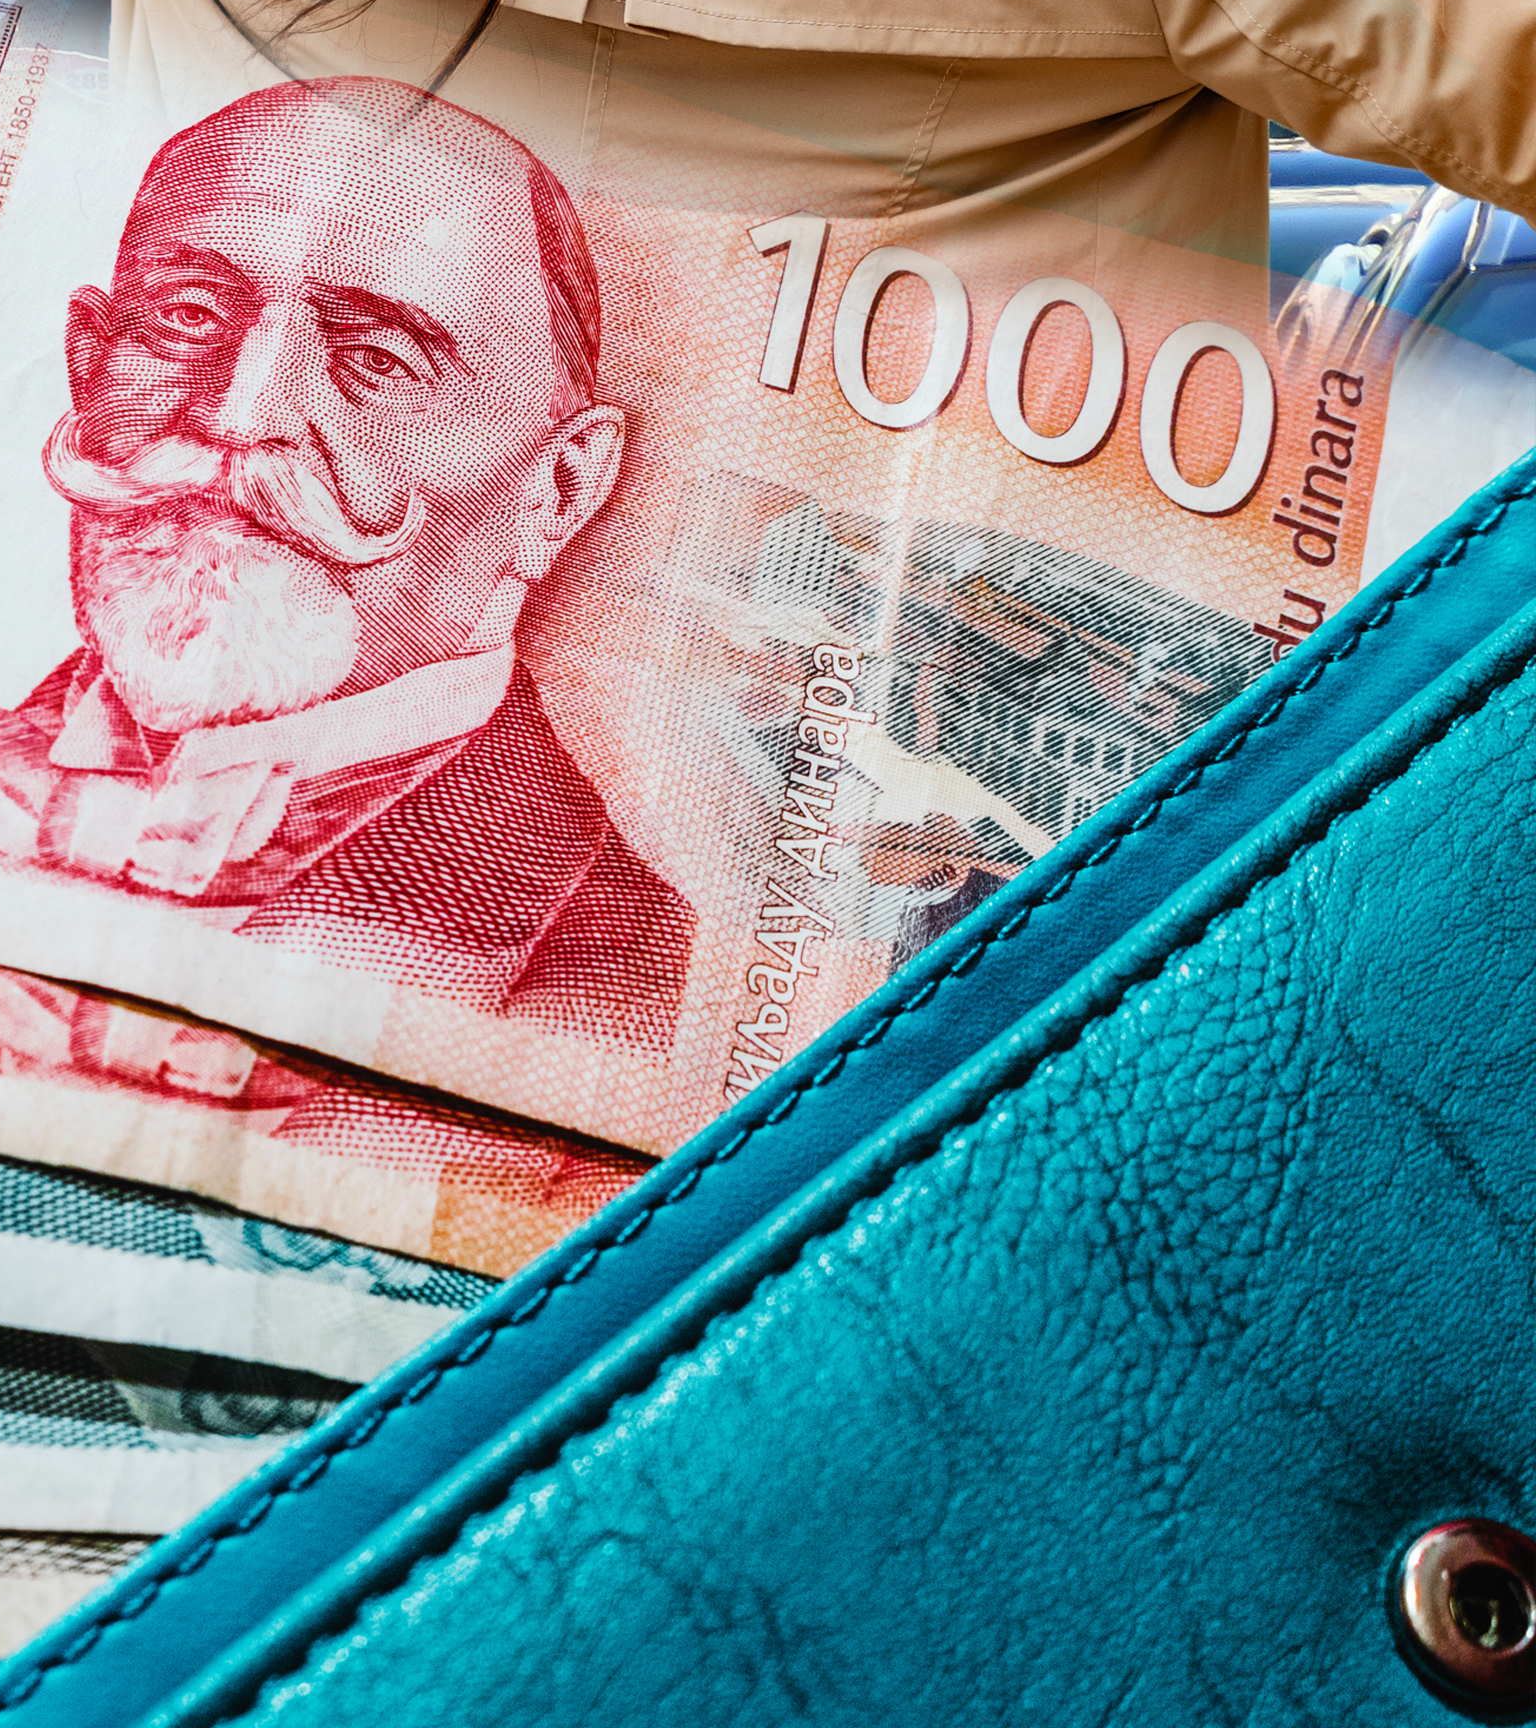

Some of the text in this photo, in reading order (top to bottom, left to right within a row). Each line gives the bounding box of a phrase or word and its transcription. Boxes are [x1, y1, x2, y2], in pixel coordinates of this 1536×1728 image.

[5, 41, 51, 142] 1850-1937
[745, 205, 1279, 519] 1000
[1271, 367, 1366, 569] dinara
[773, 640, 887, 882] динара
